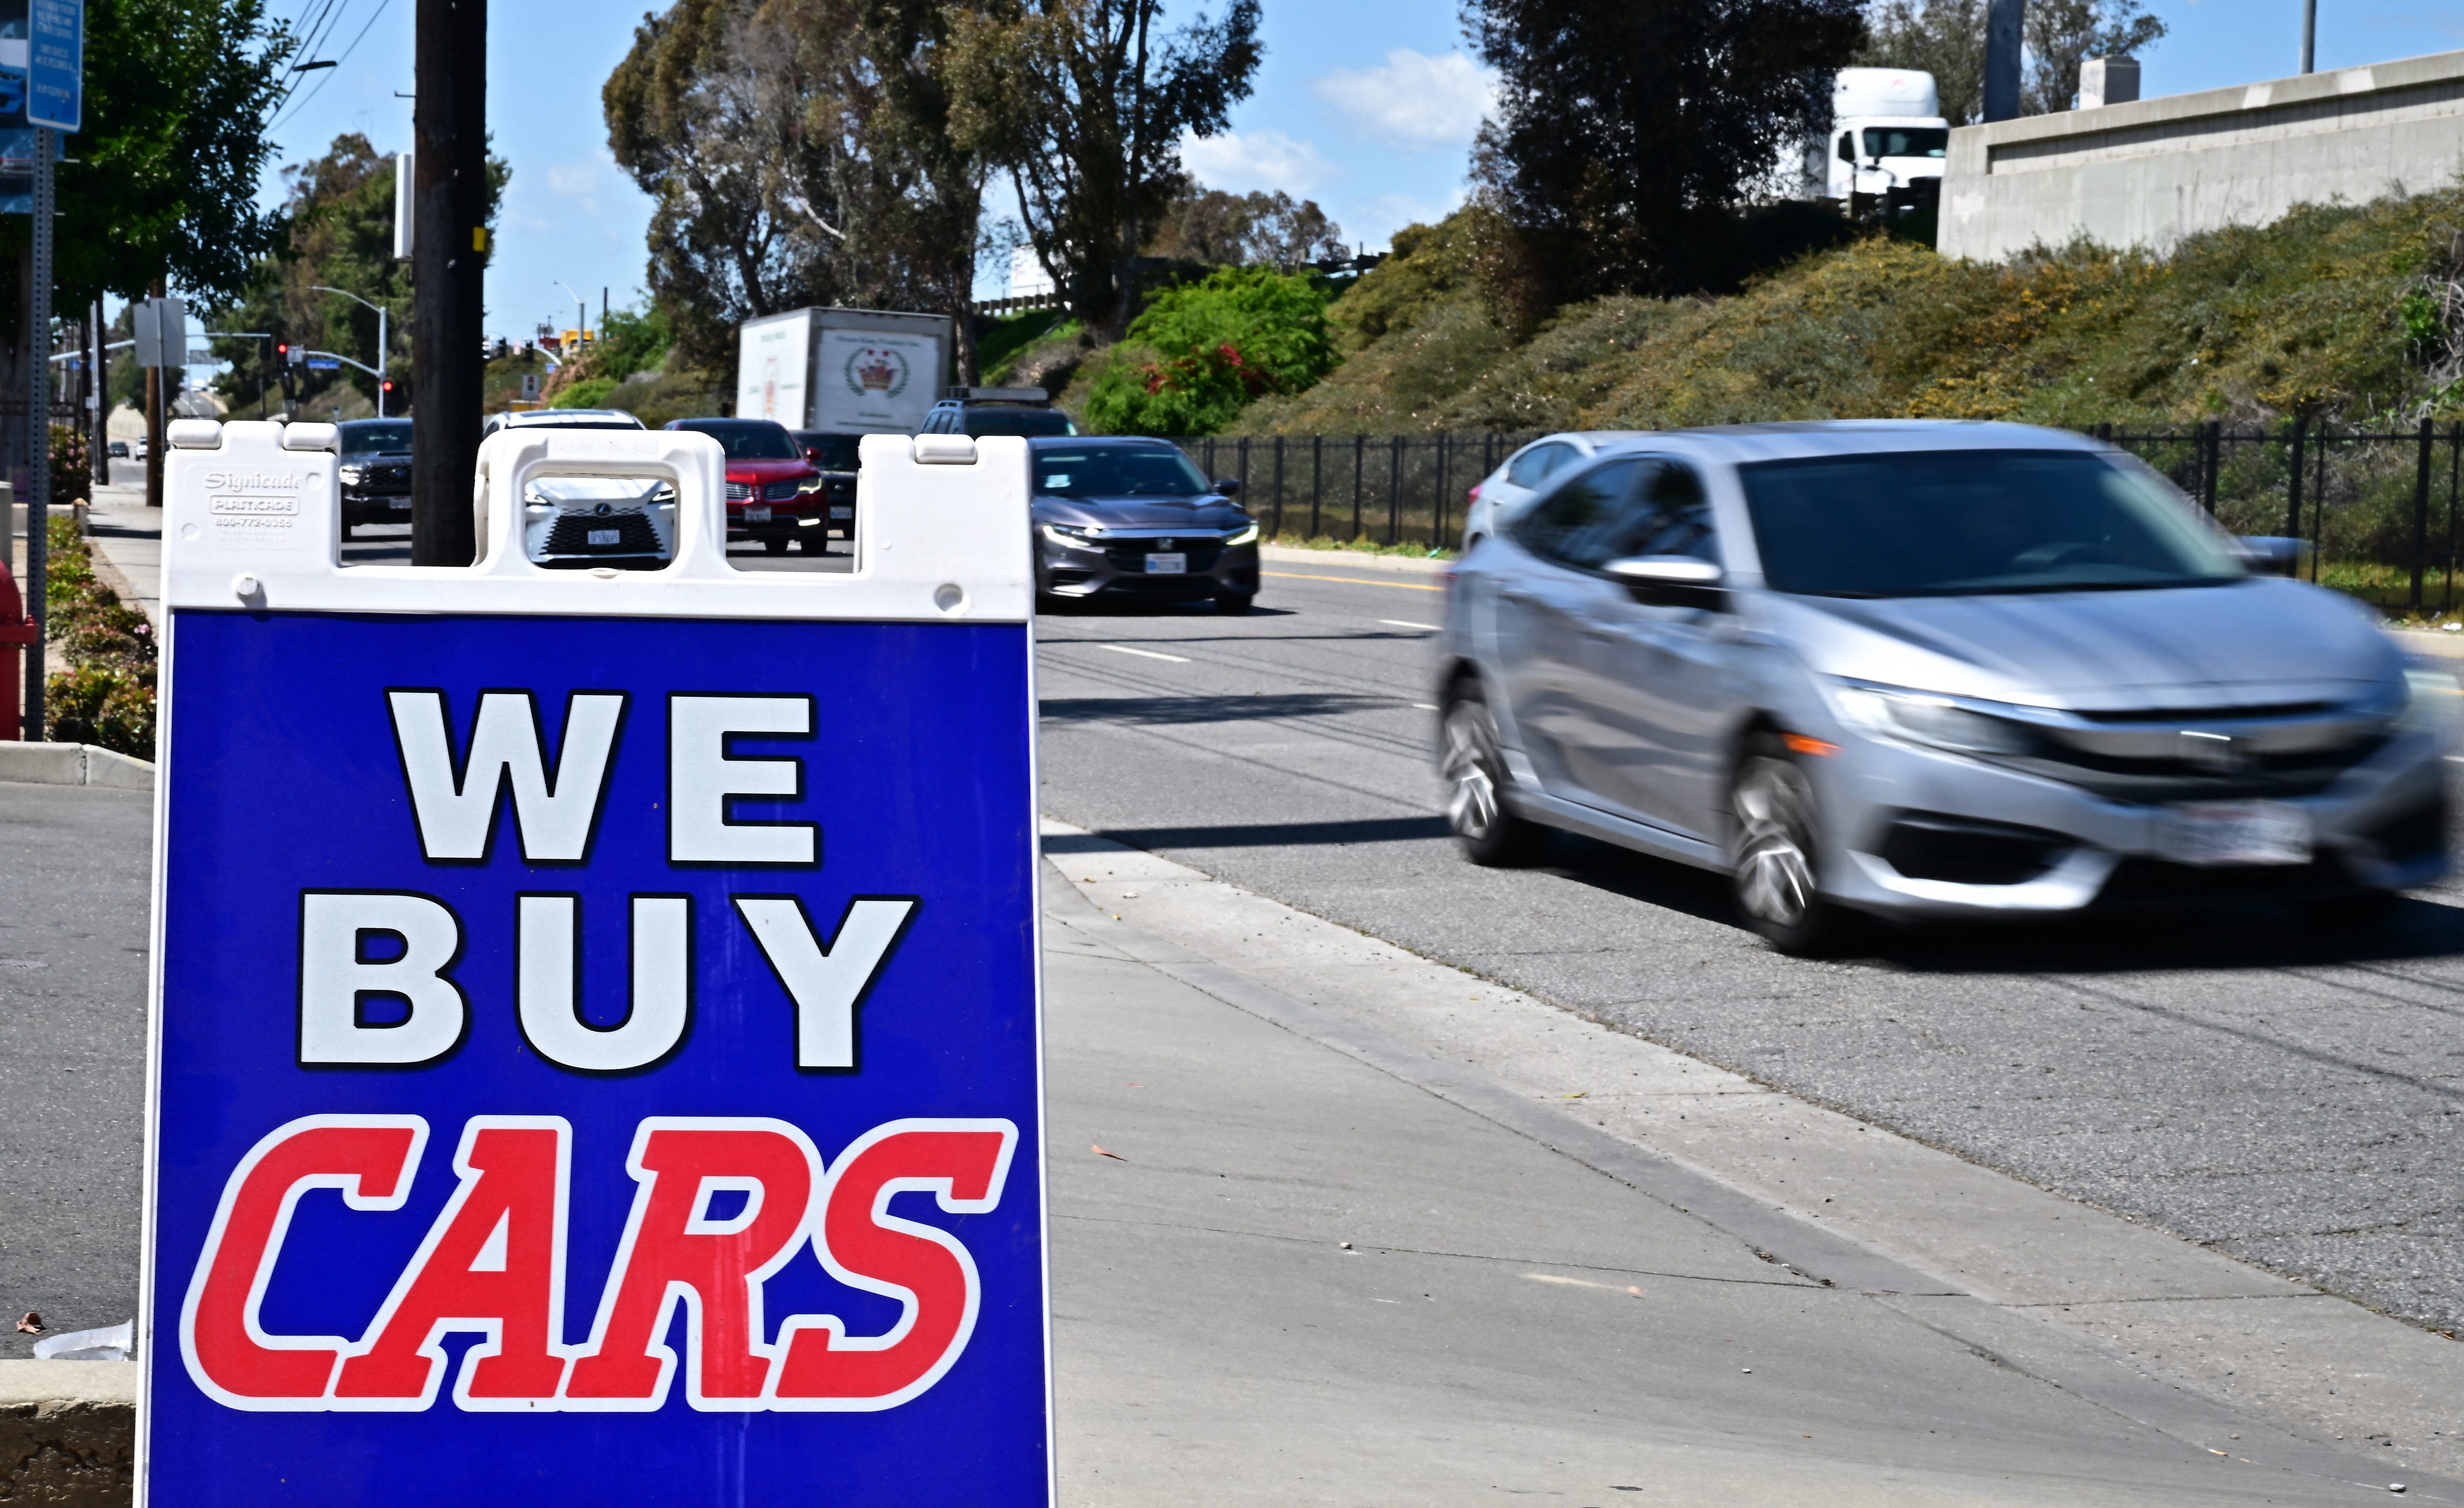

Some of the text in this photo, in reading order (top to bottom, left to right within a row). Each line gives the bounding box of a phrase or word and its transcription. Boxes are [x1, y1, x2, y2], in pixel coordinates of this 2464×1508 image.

[214, 500, 293, 512] PLASTICADE
[386, 689, 818, 866] WE
[298, 891, 917, 1074] BUY
[179, 1114, 1018, 1412] CARS
